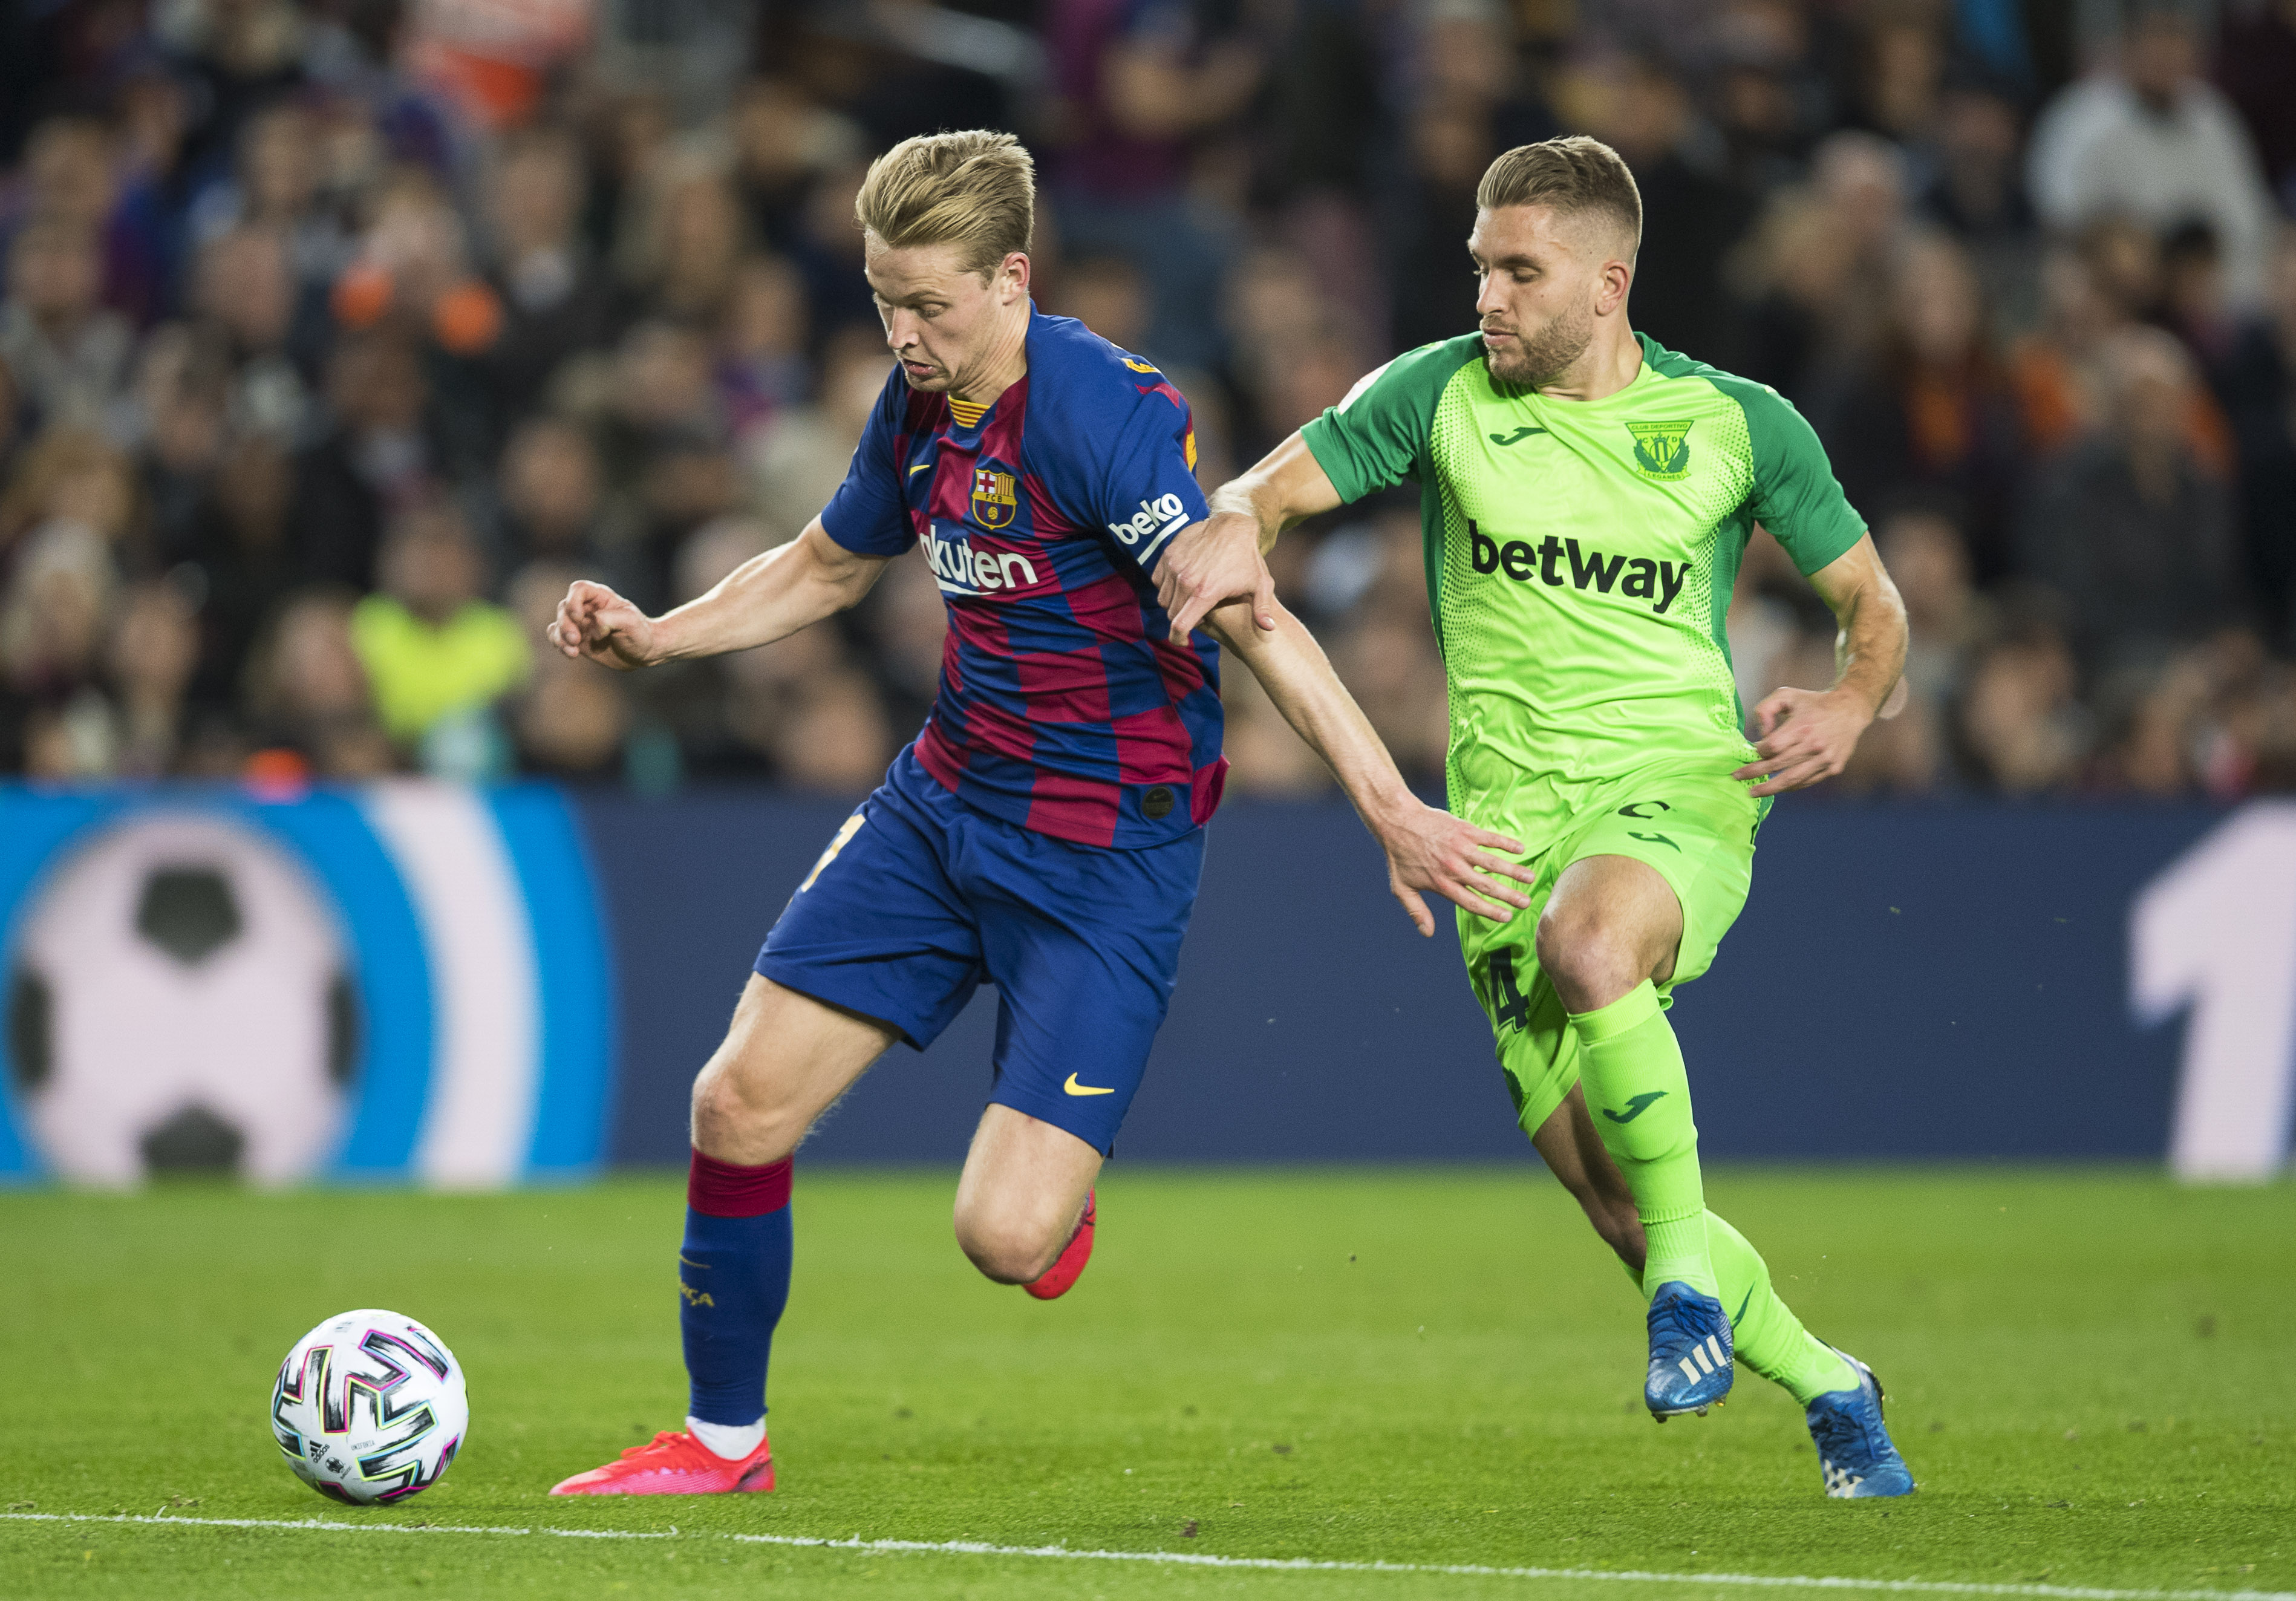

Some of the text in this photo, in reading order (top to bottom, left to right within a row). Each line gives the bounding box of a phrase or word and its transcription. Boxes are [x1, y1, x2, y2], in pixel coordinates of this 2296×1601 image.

[985, 494, 1003, 503] FCB
[1108, 493, 1184, 545] beko
[919, 524, 1039, 589] akuten
[1468, 518, 1694, 614] betway
[313, 1443, 330, 1463] adidas
